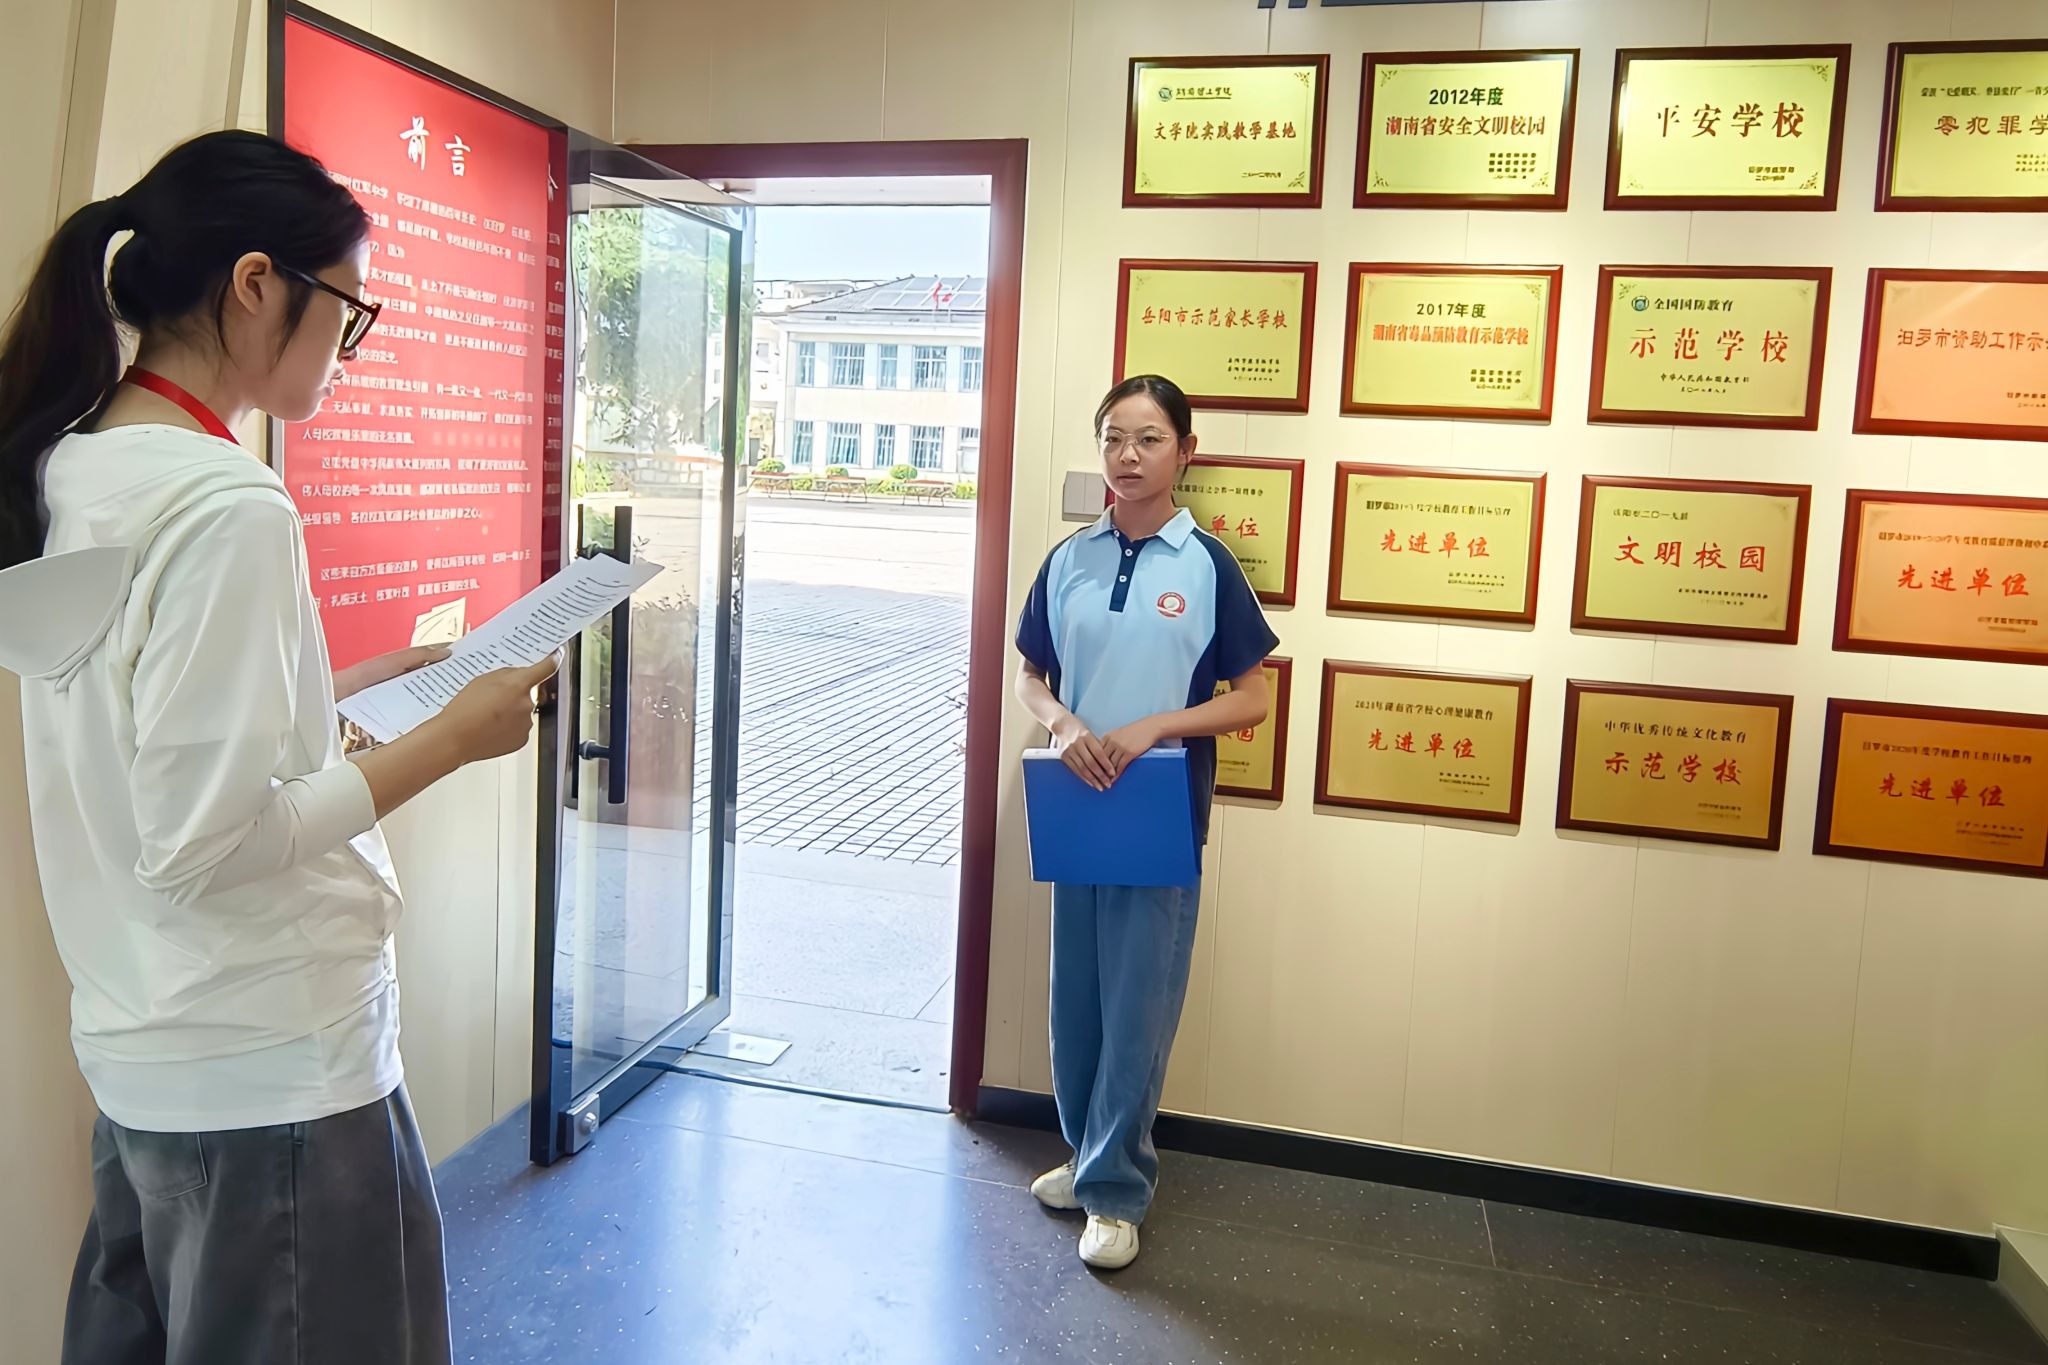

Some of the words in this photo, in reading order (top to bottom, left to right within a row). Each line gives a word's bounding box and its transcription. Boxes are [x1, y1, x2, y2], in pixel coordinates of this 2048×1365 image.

[1429, 87, 1504, 106] 2012年度
[1154, 120, 1297, 141] 文学院实践教学基地
[1386, 115, 1545, 136] 湖南省安全文明校园
[1657, 102, 1804, 137] 平安学校
[399, 115, 471, 176] 前言
[1141, 306, 1288, 329] 岳阳市示范家长学校
[1416, 303, 1486, 319] 2017年度
[1654, 298, 1734, 312] 全国国防教育
[1373, 324, 1529, 345] 湖南省毒品预防教育示范学校
[1630, 327, 1789, 363] 示范学校
[1897, 328, 2048, 352] 汨罗市资助工作示
[1380, 529, 1490, 559] 先进单位
[1614, 536, 1766, 572] 文明校园
[1898, 564, 2030, 597] 先进单位
[1368, 729, 1476, 759] 先进单位
[1605, 720, 1747, 744] 中华优秀传统文化教育
[1605, 752, 1742, 785] 示范学校
[1879, 773, 2006, 807] 先进单位
